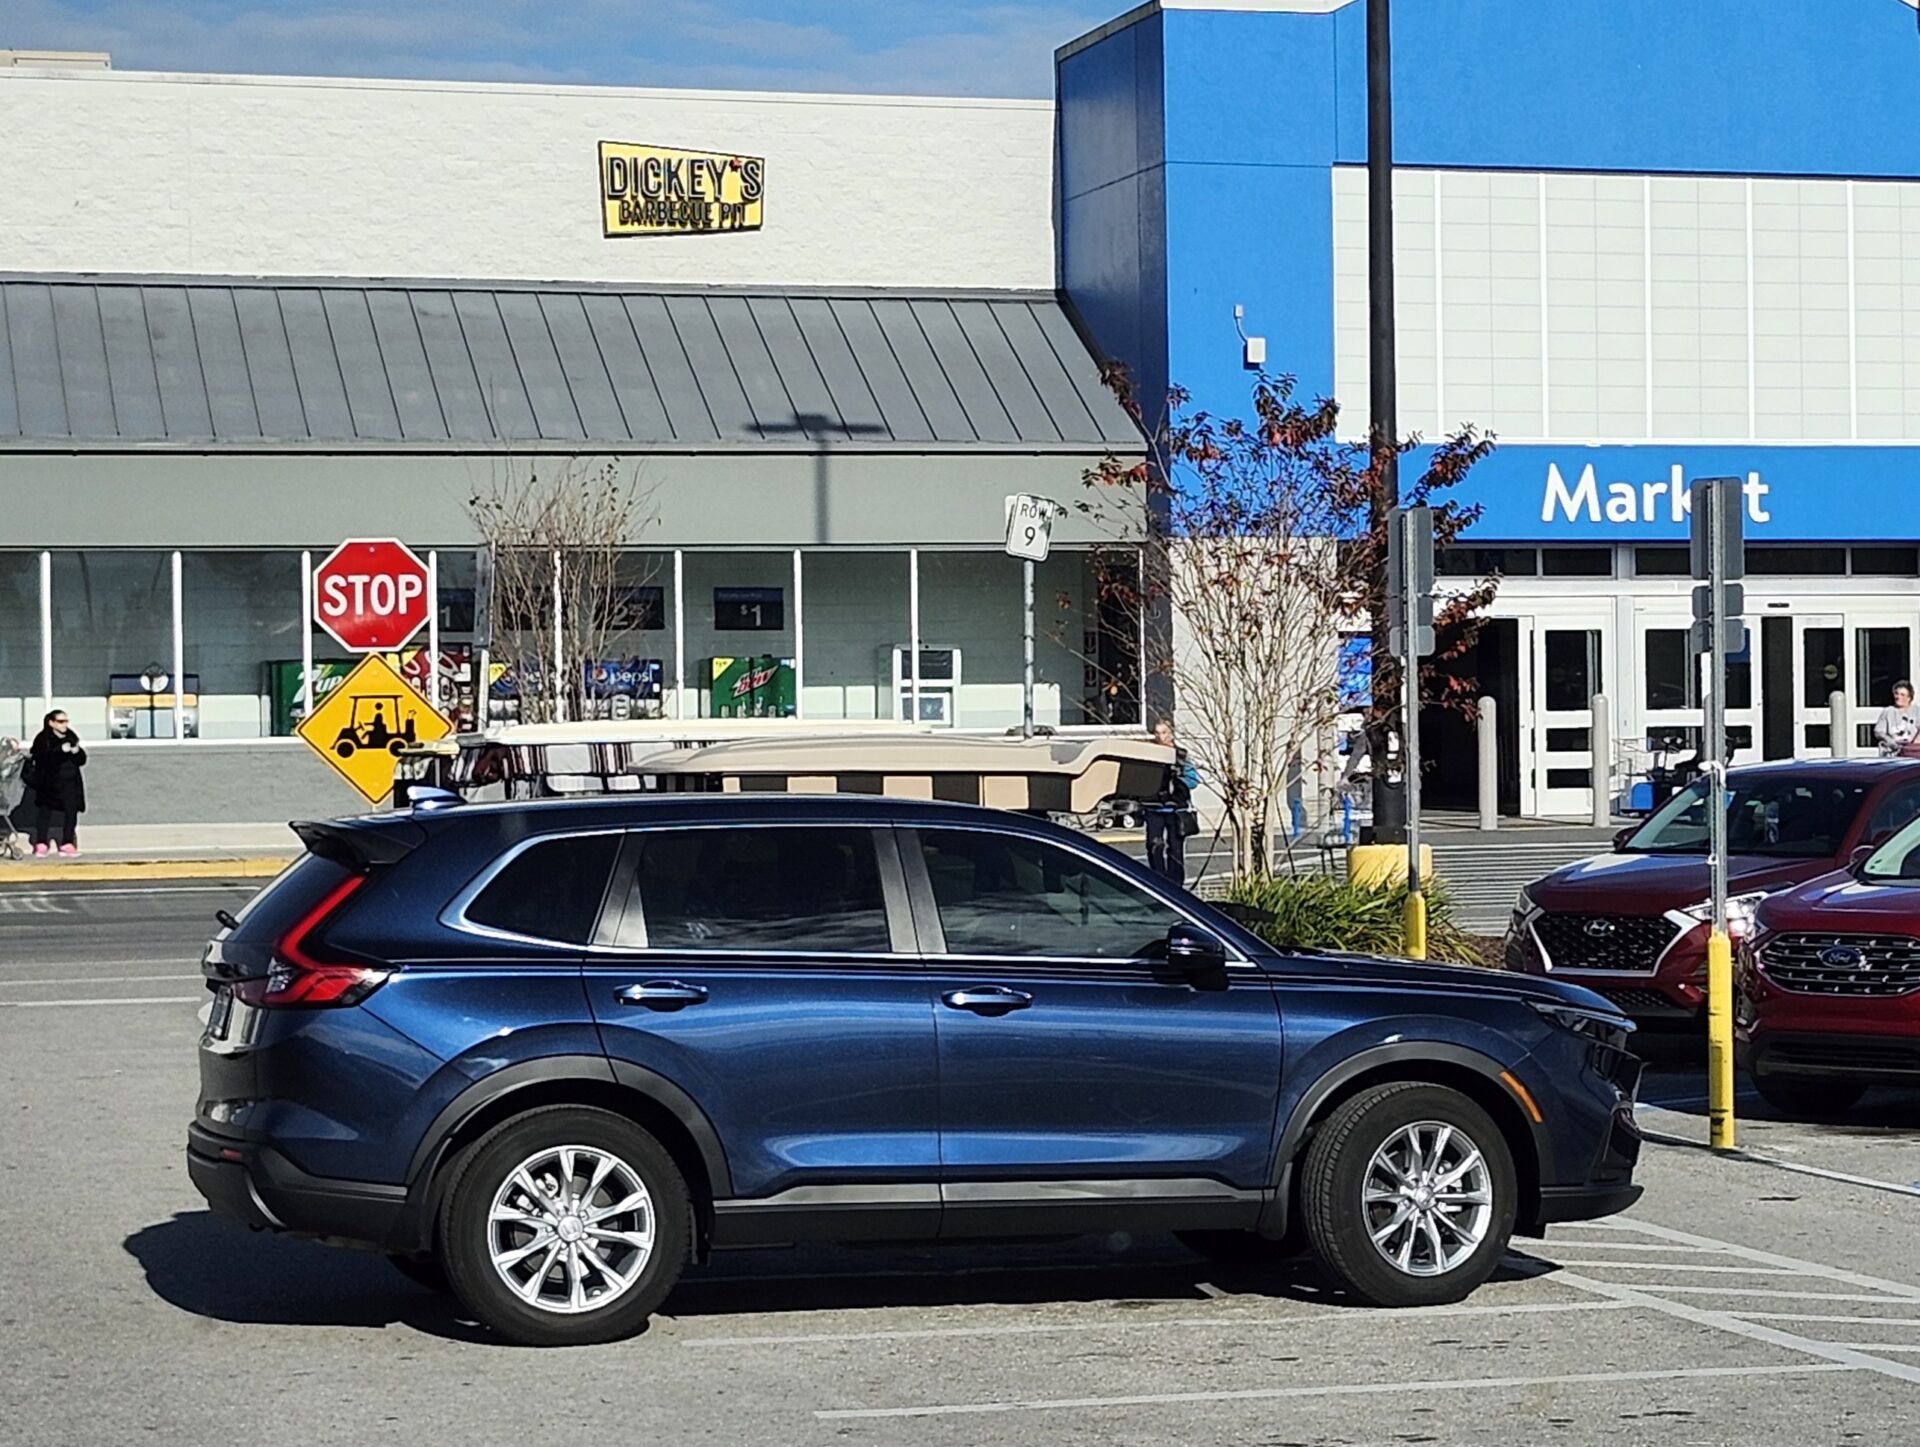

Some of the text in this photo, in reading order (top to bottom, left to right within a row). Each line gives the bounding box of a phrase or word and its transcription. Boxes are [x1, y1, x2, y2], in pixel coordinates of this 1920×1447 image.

[606, 156, 764, 203] DICKEY'S
[619, 200, 746, 229] BARBECUE PIT
[1541, 463, 1770, 523] Markt
[1025, 526, 1036, 546] 9
[323, 574, 422, 617] STOP
